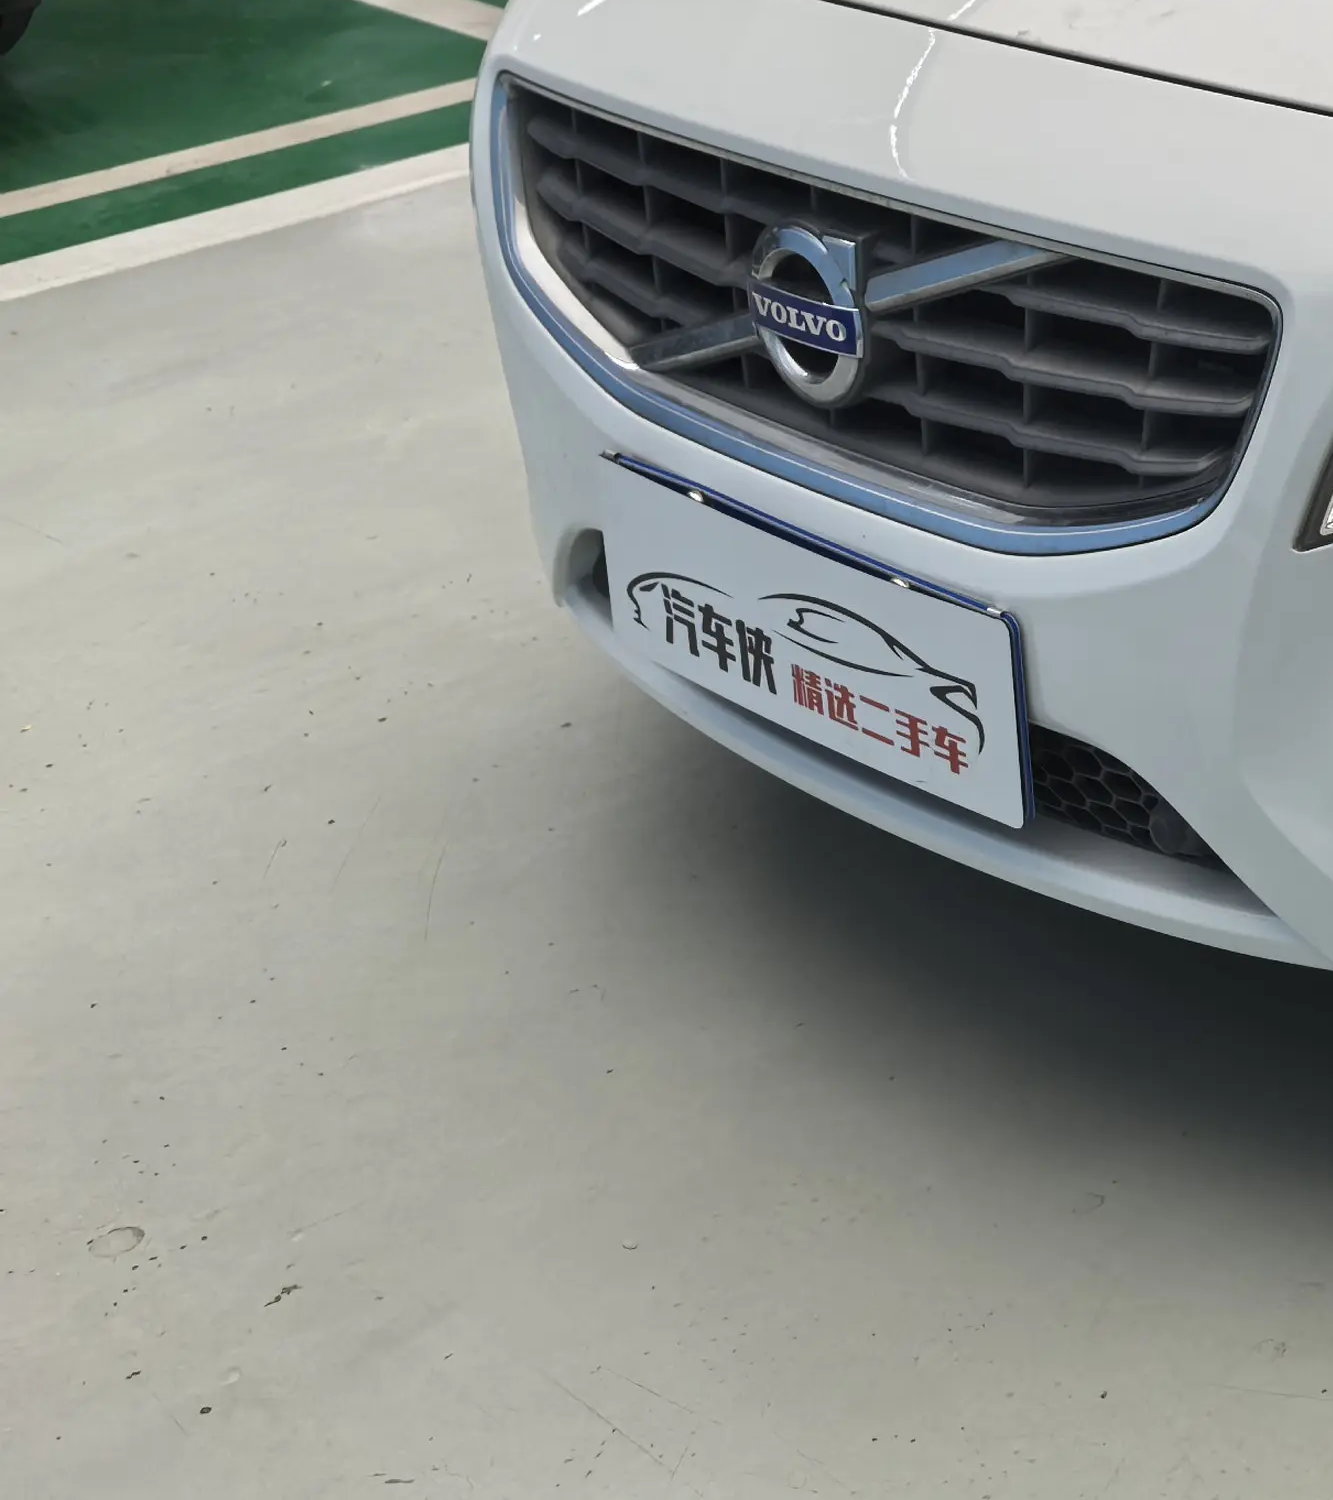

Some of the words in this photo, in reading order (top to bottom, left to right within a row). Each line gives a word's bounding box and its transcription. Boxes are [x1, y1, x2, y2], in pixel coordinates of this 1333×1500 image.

[752, 291, 847, 342] VOLVO
[661, 583, 777, 695] 汽车侠
[791, 663, 969, 775] 精选二手车
